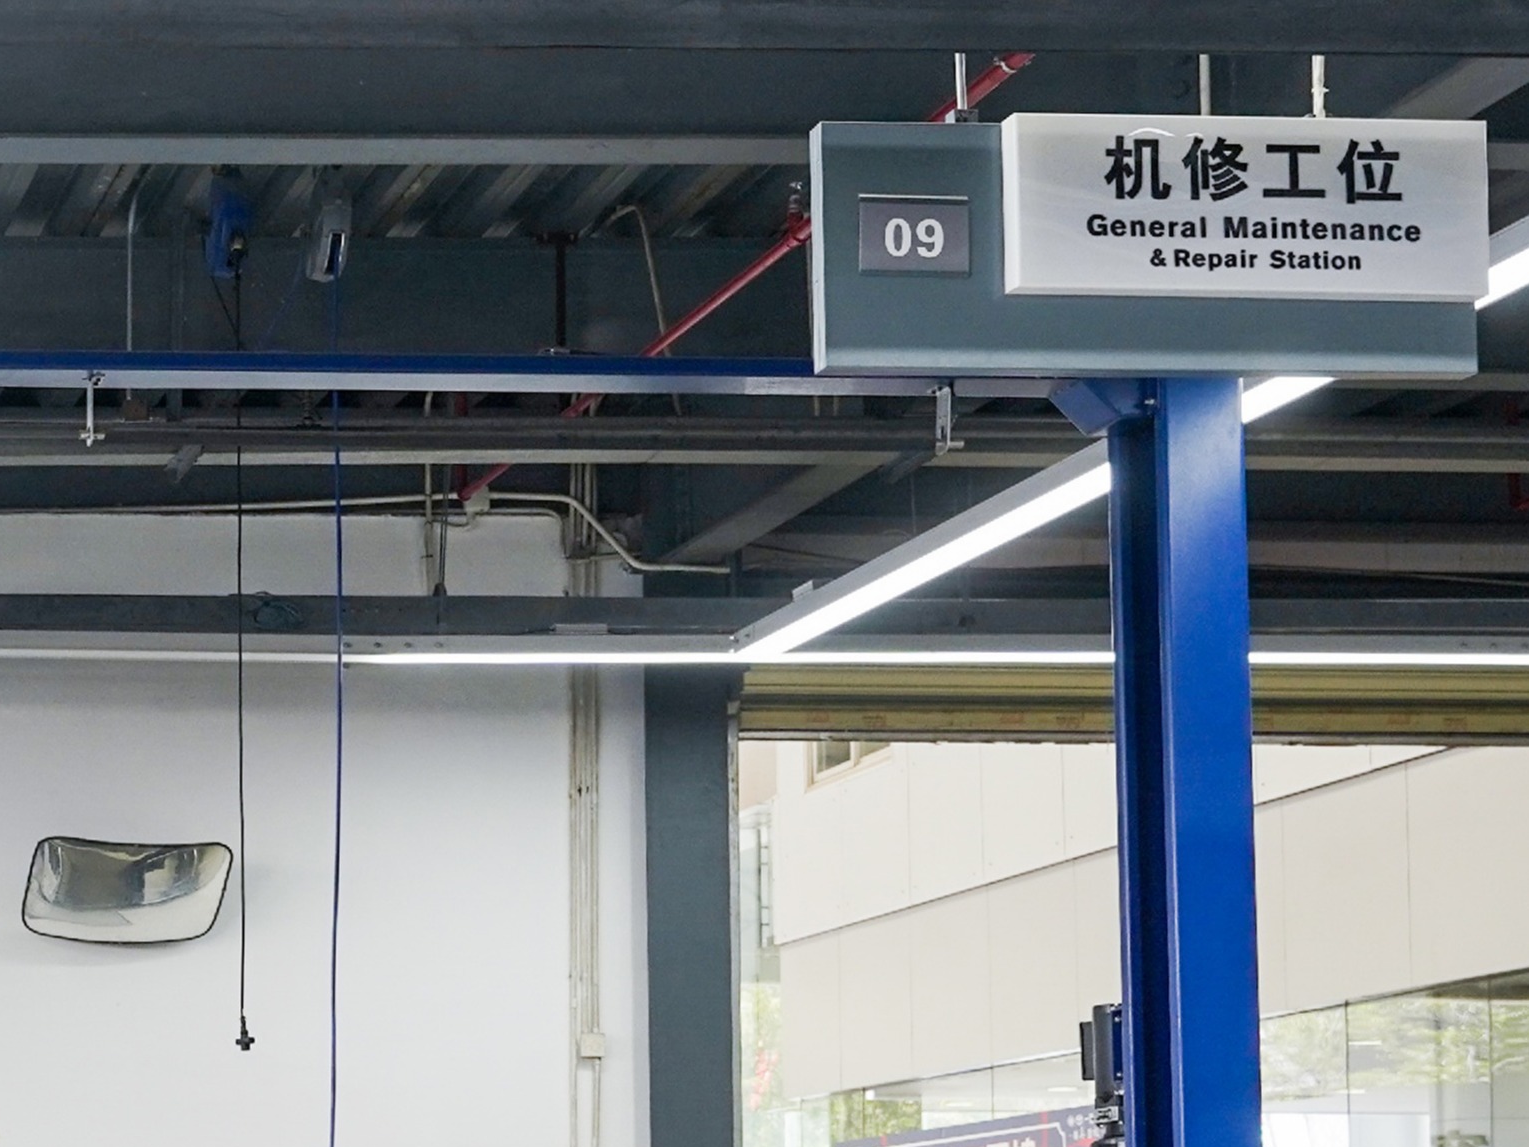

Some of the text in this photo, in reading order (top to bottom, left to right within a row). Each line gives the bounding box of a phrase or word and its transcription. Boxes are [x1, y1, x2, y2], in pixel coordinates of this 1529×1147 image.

[1103, 134, 1404, 203] 机修工位
[883, 217, 945, 258] 09
[1085, 213, 1422, 243] General Maintenance
[1149, 247, 1362, 272] & Repair Station
